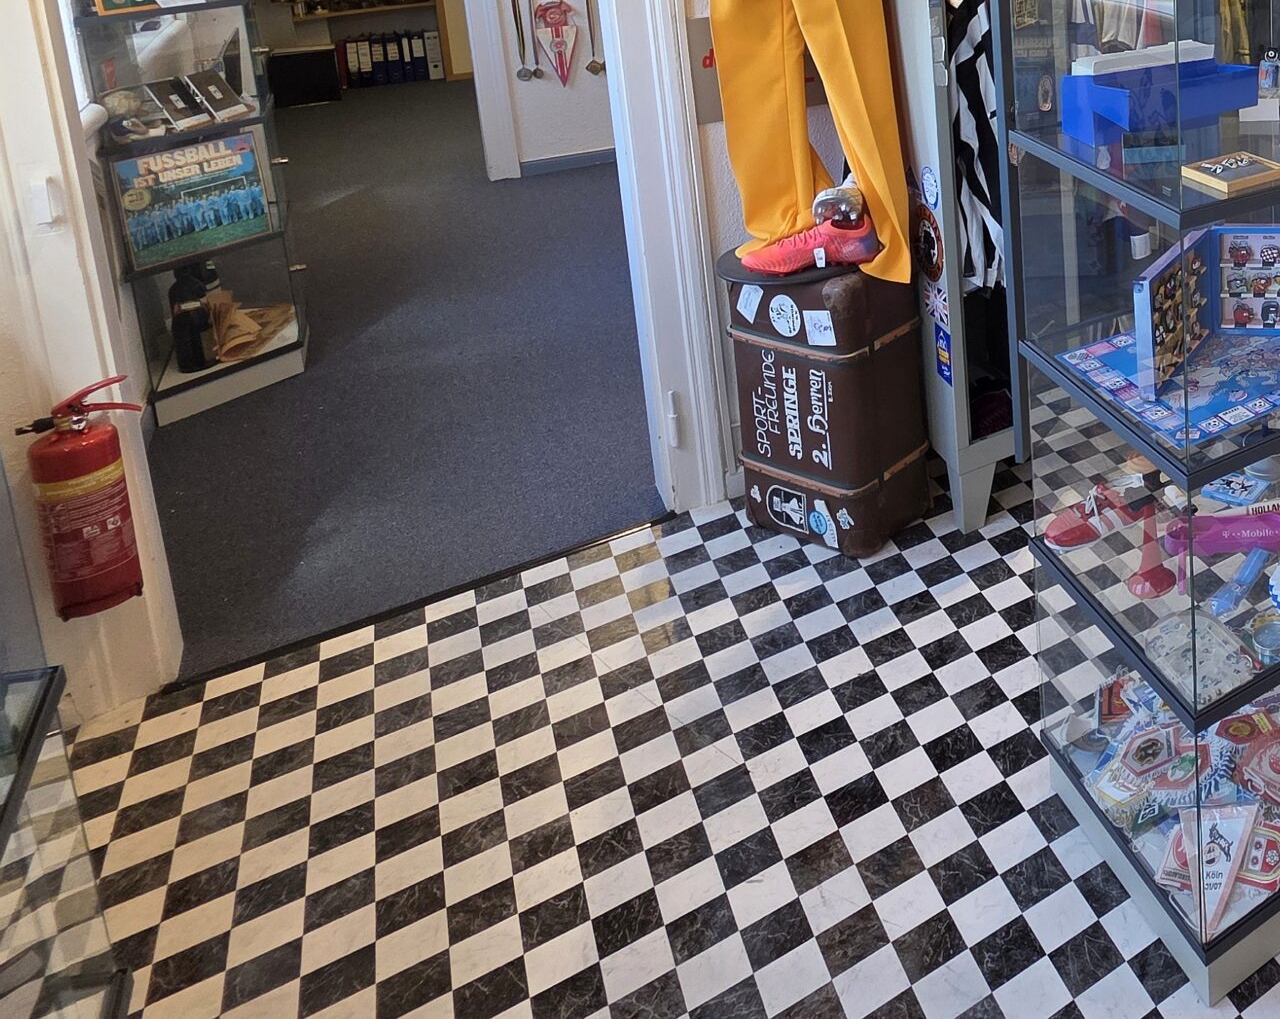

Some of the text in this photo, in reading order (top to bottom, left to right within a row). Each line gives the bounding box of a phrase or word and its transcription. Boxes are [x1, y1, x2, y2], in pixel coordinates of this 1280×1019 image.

[133, 154, 243, 189] IST UNSER LEBEN
[137, 141, 232, 175] FUSSBALL
[752, 386, 772, 457] SPORT-
[762, 349, 781, 435] FREUNDE
[782, 366, 802, 460] SPRINGE
[807, 369, 829, 468] 2. Herren
[1205, 870, 1224, 879] Köln
